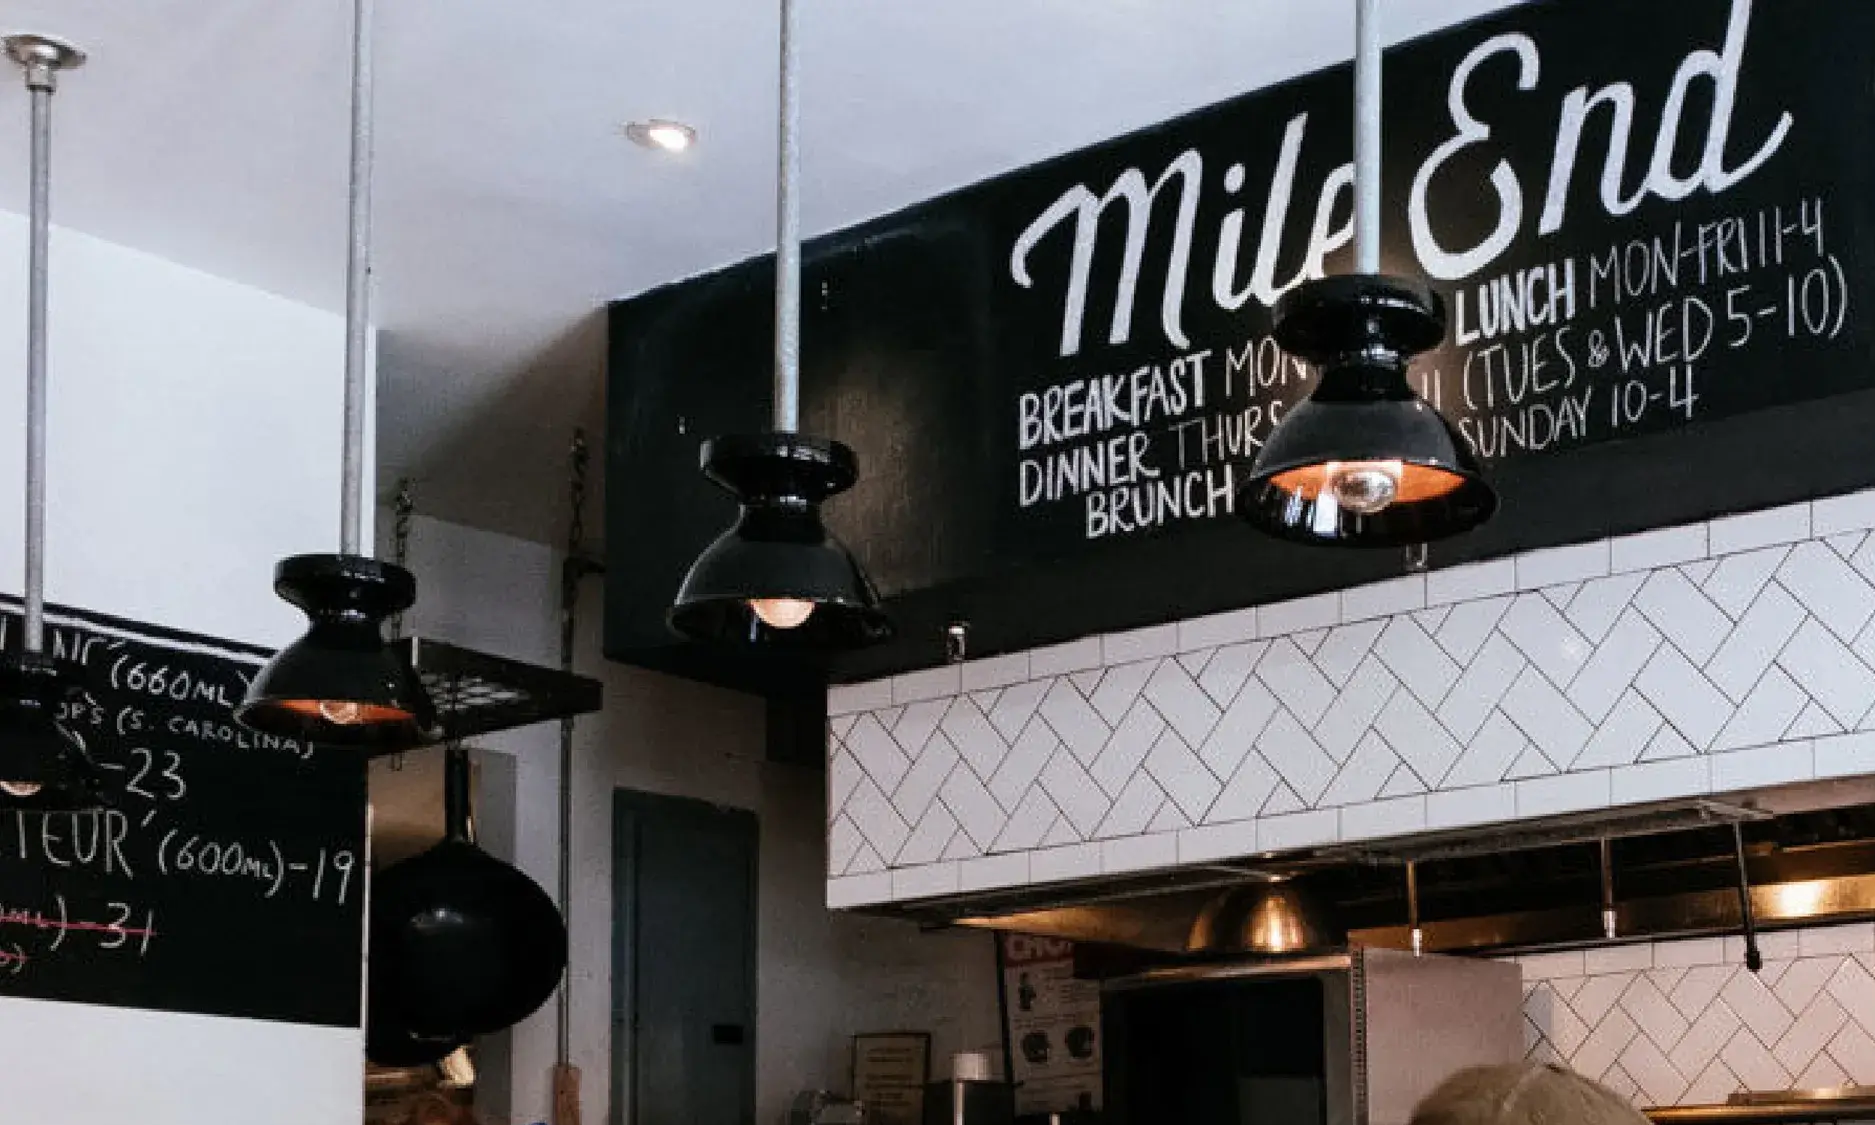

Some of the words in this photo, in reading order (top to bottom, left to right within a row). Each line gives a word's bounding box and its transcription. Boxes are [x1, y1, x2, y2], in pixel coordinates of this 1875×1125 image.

[1407, 0, 1793, 280] End
[1019, 349, 1213, 450] BREAKFAST
[1455, 257, 1576, 347] LUNCH
[1019, 430, 1161, 508] DINNER
[1462, 325, 1577, 411] (TUES
[1588, 328, 1610, 368] &
[1614, 296, 1714, 374] WED
[1726, 252, 1848, 349] 5-10)
[1085, 462, 1236, 539] BRUNCH
[1457, 384, 1593, 459] SUNDAY
[1611, 365, 1700, 428] 10-4
